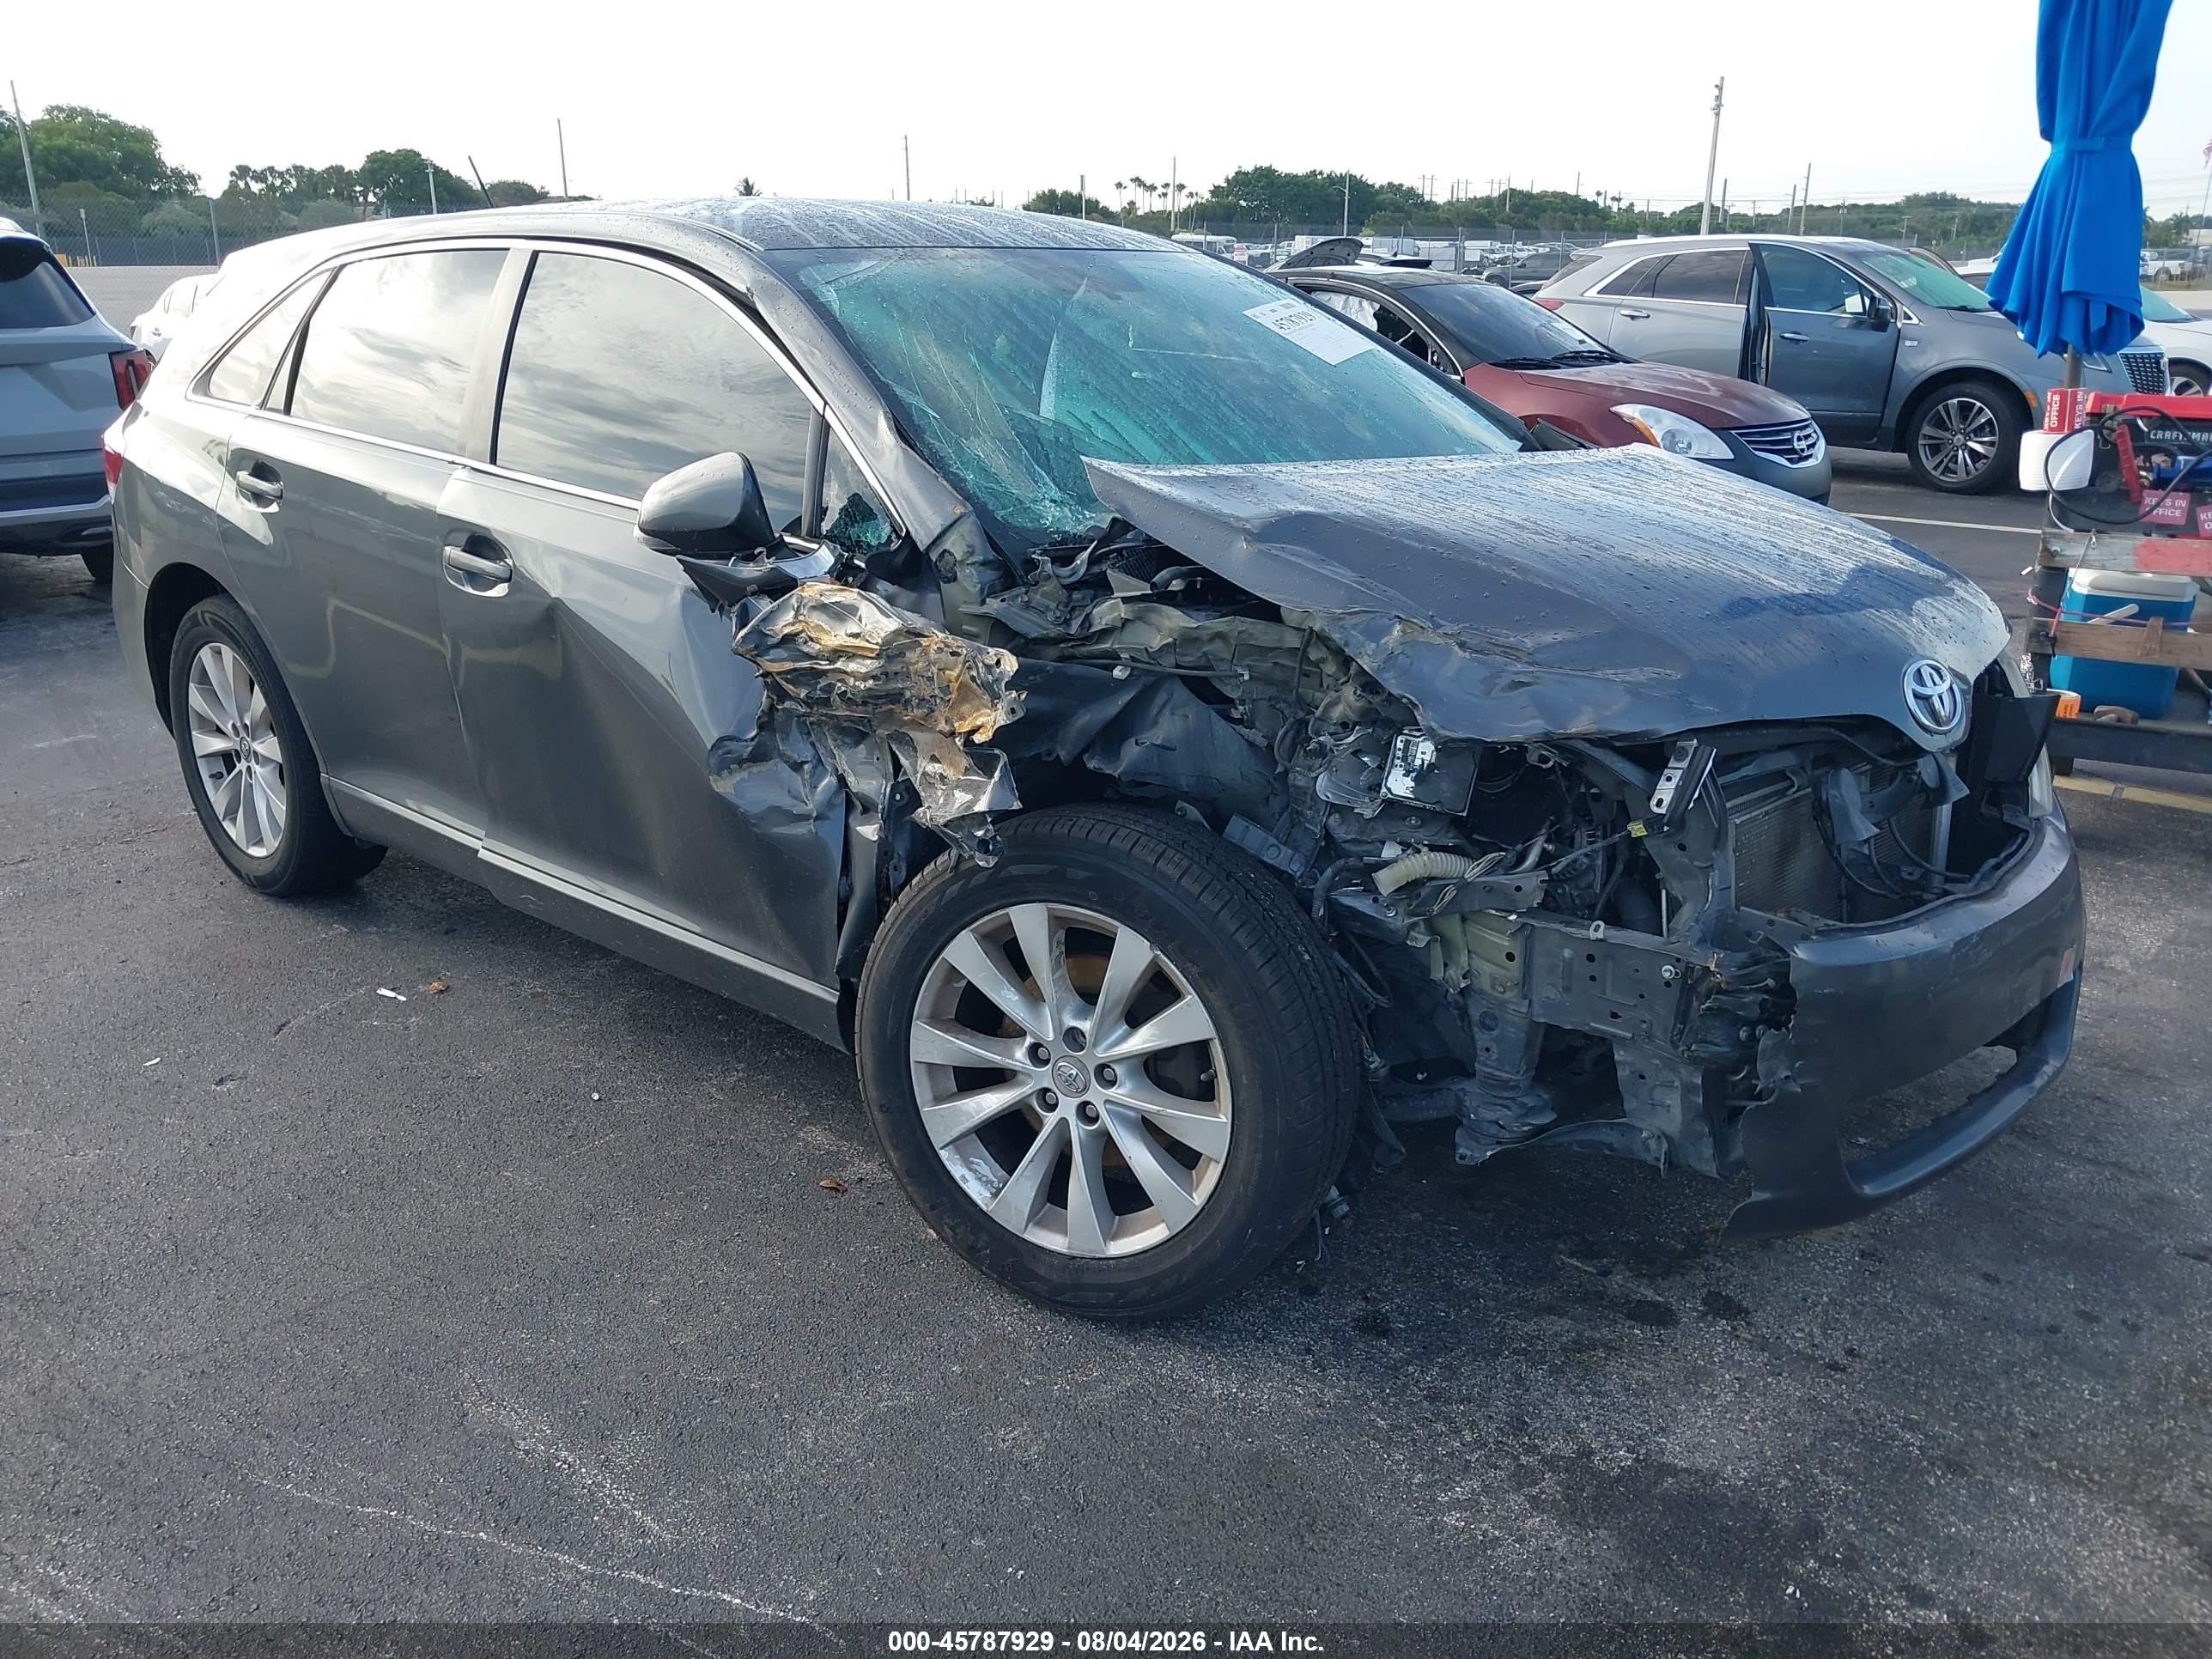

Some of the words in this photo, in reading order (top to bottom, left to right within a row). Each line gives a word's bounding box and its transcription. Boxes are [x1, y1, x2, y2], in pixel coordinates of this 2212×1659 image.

[2076, 392, 2084, 402] IN
[2050, 394, 2061, 428] OFFICE
[2074, 404, 2084, 429] KEYS
[2144, 497, 2172, 507] KES
[2174, 499, 2187, 507] IN
[2145, 507, 2183, 517] FFICE
